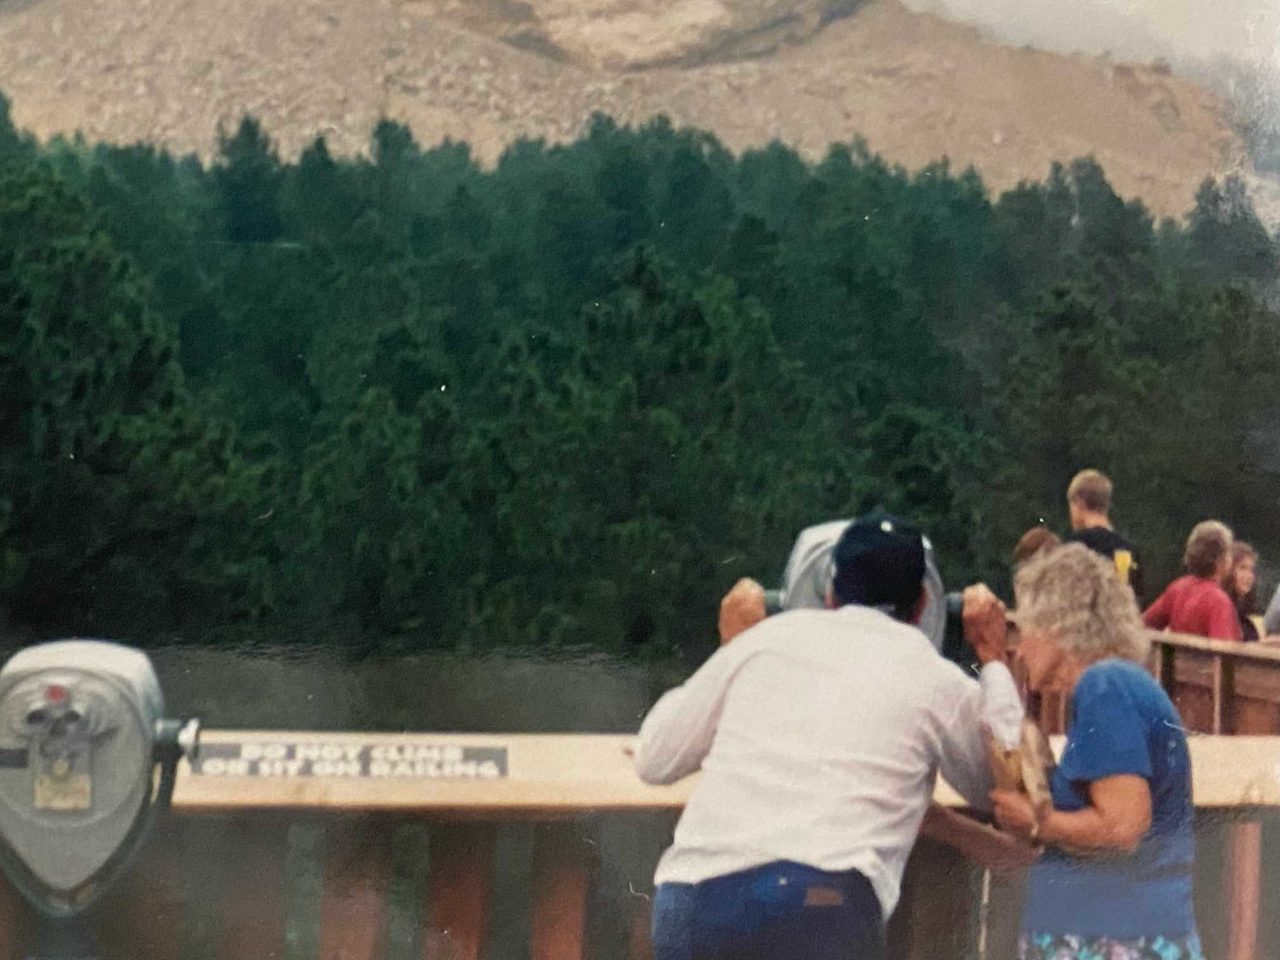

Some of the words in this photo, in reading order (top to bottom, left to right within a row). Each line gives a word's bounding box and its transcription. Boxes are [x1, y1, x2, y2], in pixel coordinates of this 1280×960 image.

[240, 744, 287, 759] DO
[296, 744, 363, 760] NOT
[370, 746, 463, 761] CLIMB
